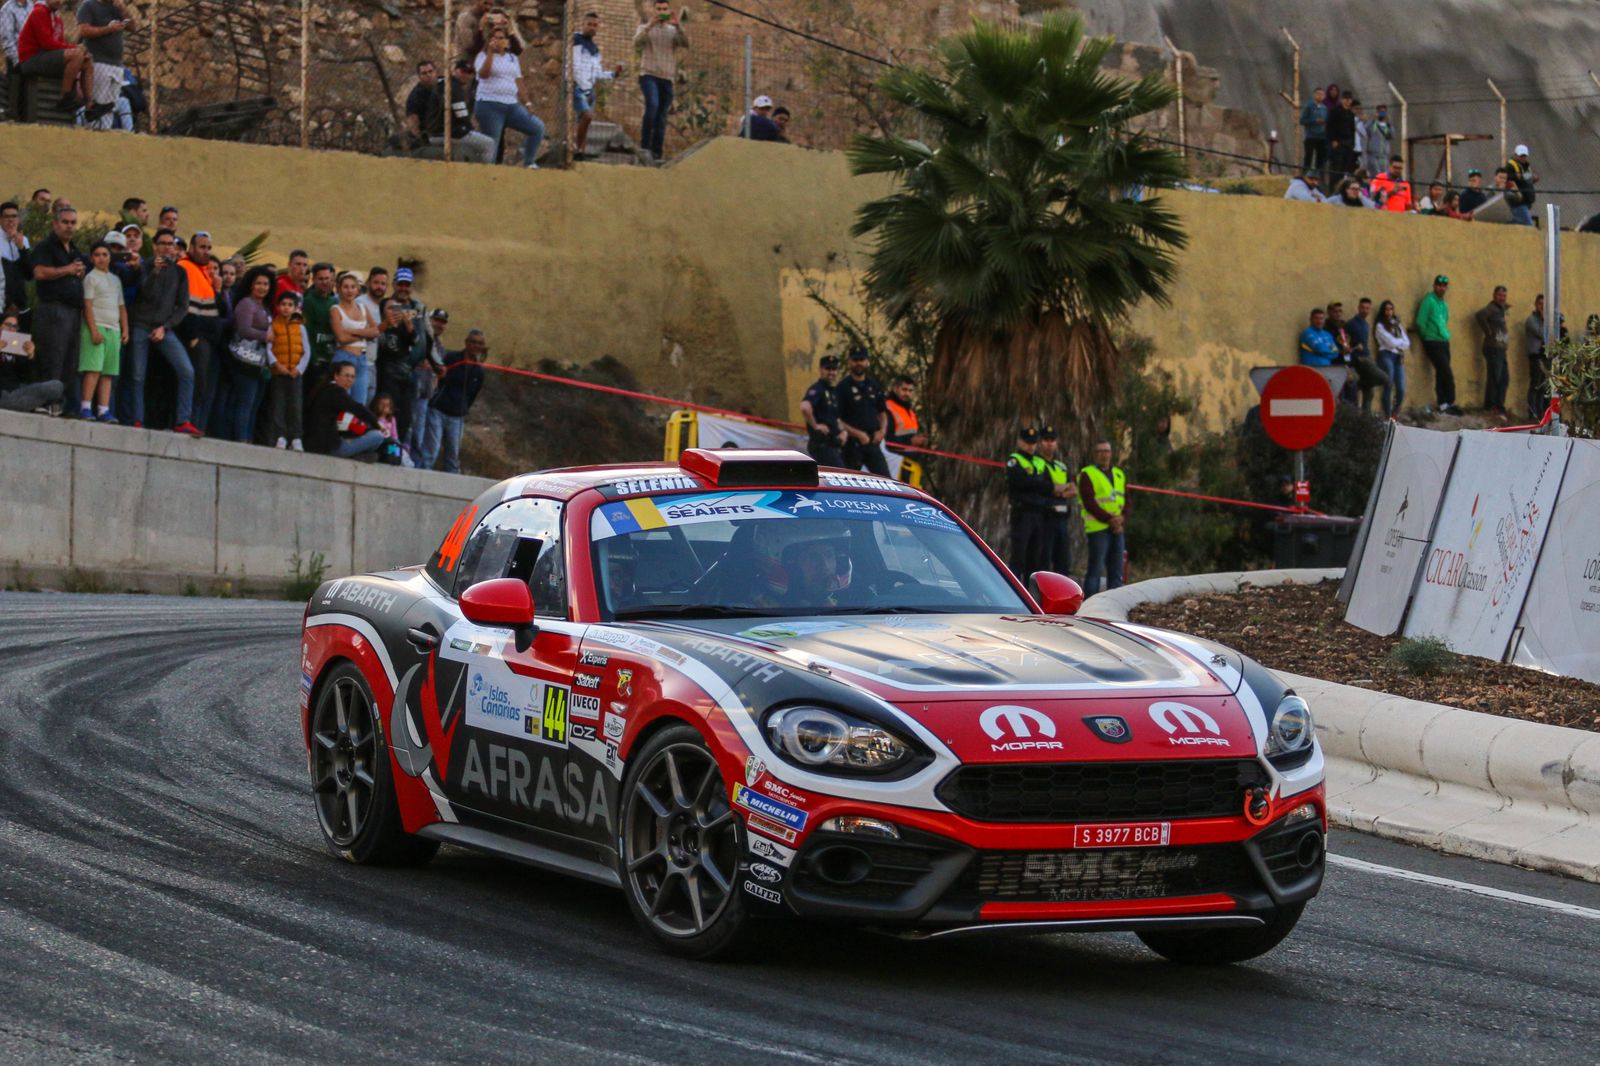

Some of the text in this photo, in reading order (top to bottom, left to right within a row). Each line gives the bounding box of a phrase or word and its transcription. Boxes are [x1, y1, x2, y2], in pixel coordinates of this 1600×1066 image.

[615, 477, 698, 495] SELENIA
[667, 505, 755, 519] SEAJETS
[825, 499, 891, 513] LOPESAN
[338, 582, 398, 614] ABARTH
[587, 653, 608, 665] Experis
[681, 640, 784, 683] ABARTH
[481, 696, 521, 721] Canarias
[573, 695, 599, 711] IVECO
[544, 687, 565, 741] 44
[573, 725, 596, 739] OZ
[991, 741, 1064, 752] MOPAR
[1168, 736, 1231, 747] MOPAR
[461, 739, 613, 835] AFRASA
[764, 780, 790, 798] SMC
[750, 797, 800, 823] MICHELIN
[1082, 829, 1091, 844] S
[1096, 828, 1130, 843] 3977
[1134, 827, 1159, 842] BCB
[755, 840, 775, 857] Rally
[745, 881, 780, 903] GALFER
